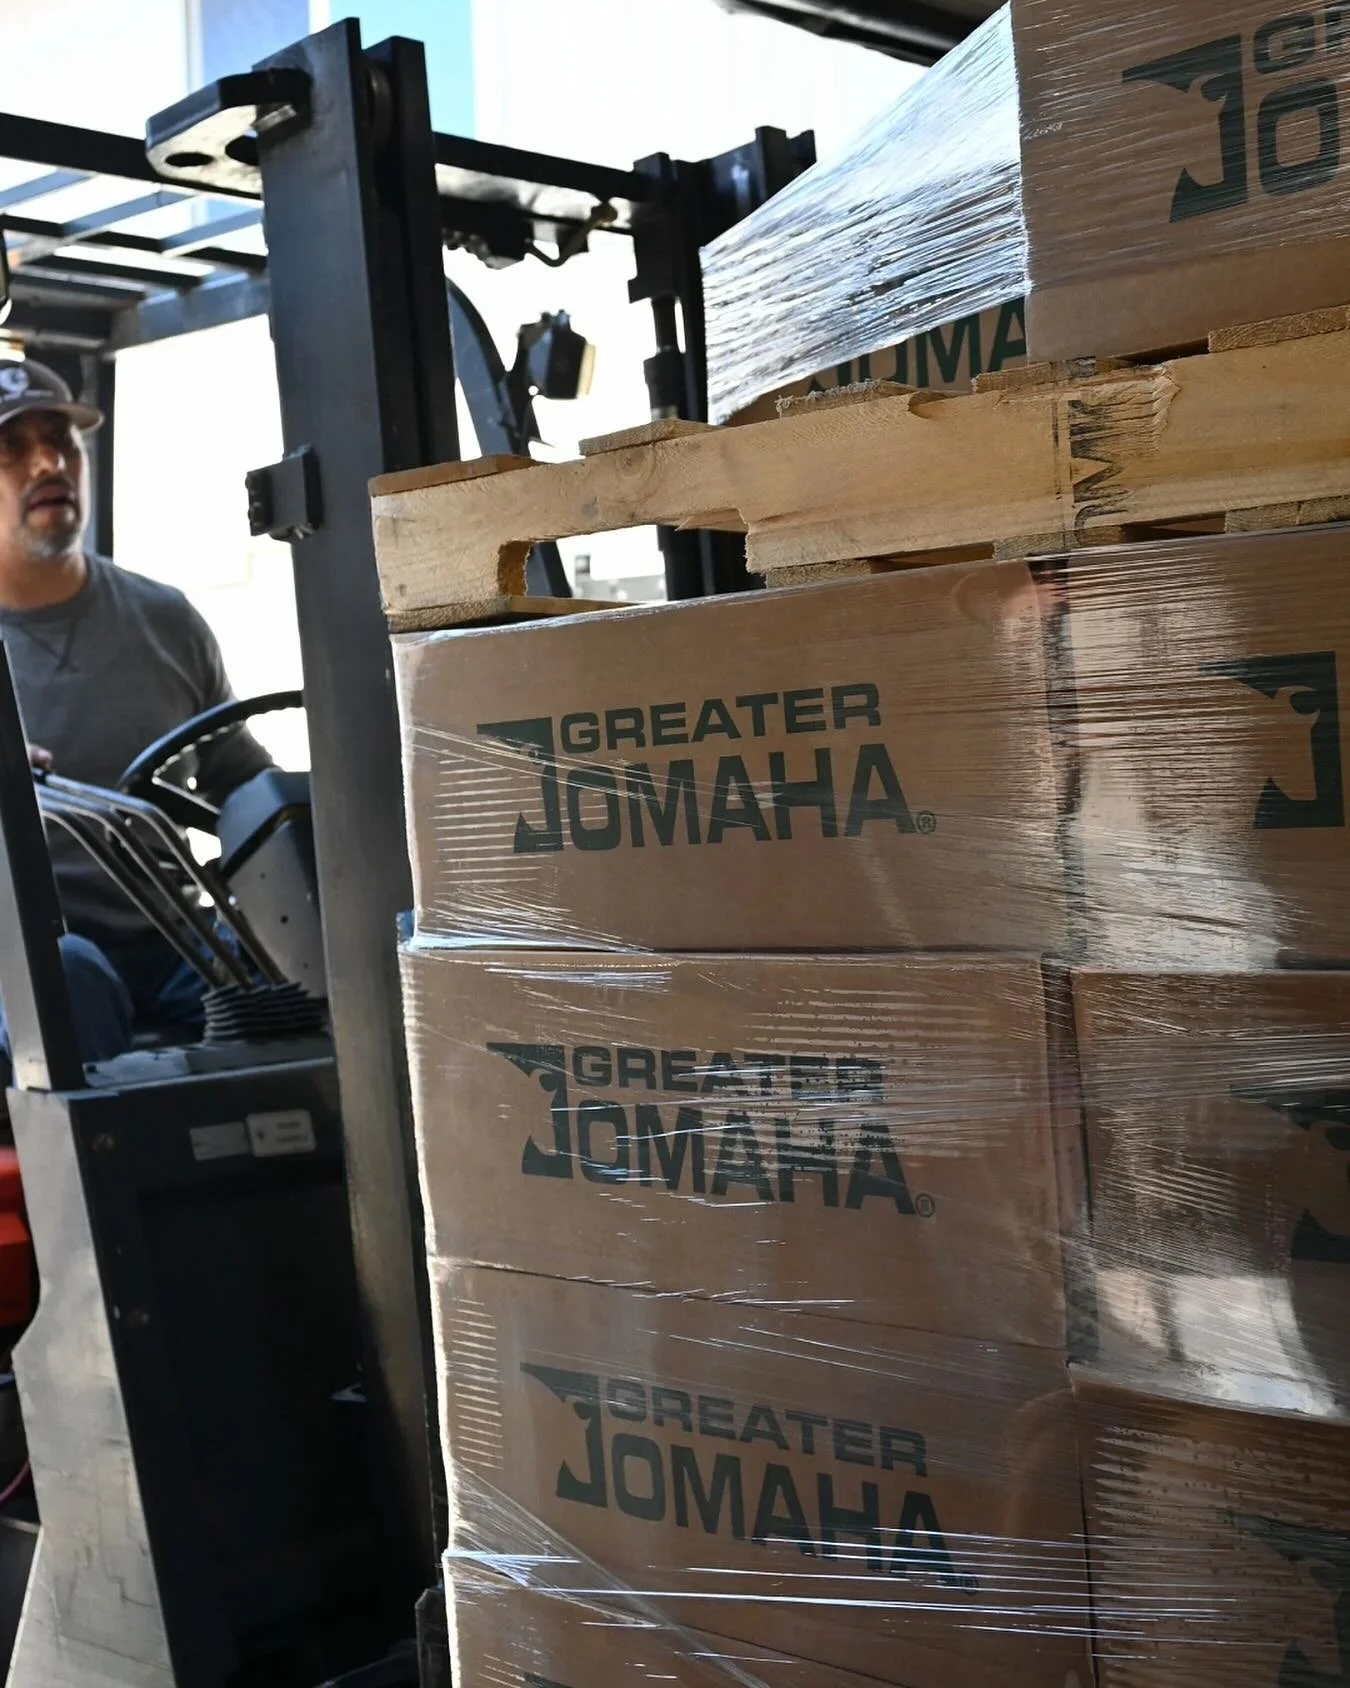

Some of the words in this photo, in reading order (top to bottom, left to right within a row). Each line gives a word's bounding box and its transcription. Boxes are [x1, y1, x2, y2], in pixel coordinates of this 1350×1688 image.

[560, 683, 881, 753] GREATER
[572, 1046, 884, 1102] GREATER
[606, 1377, 928, 1477] GREATER
